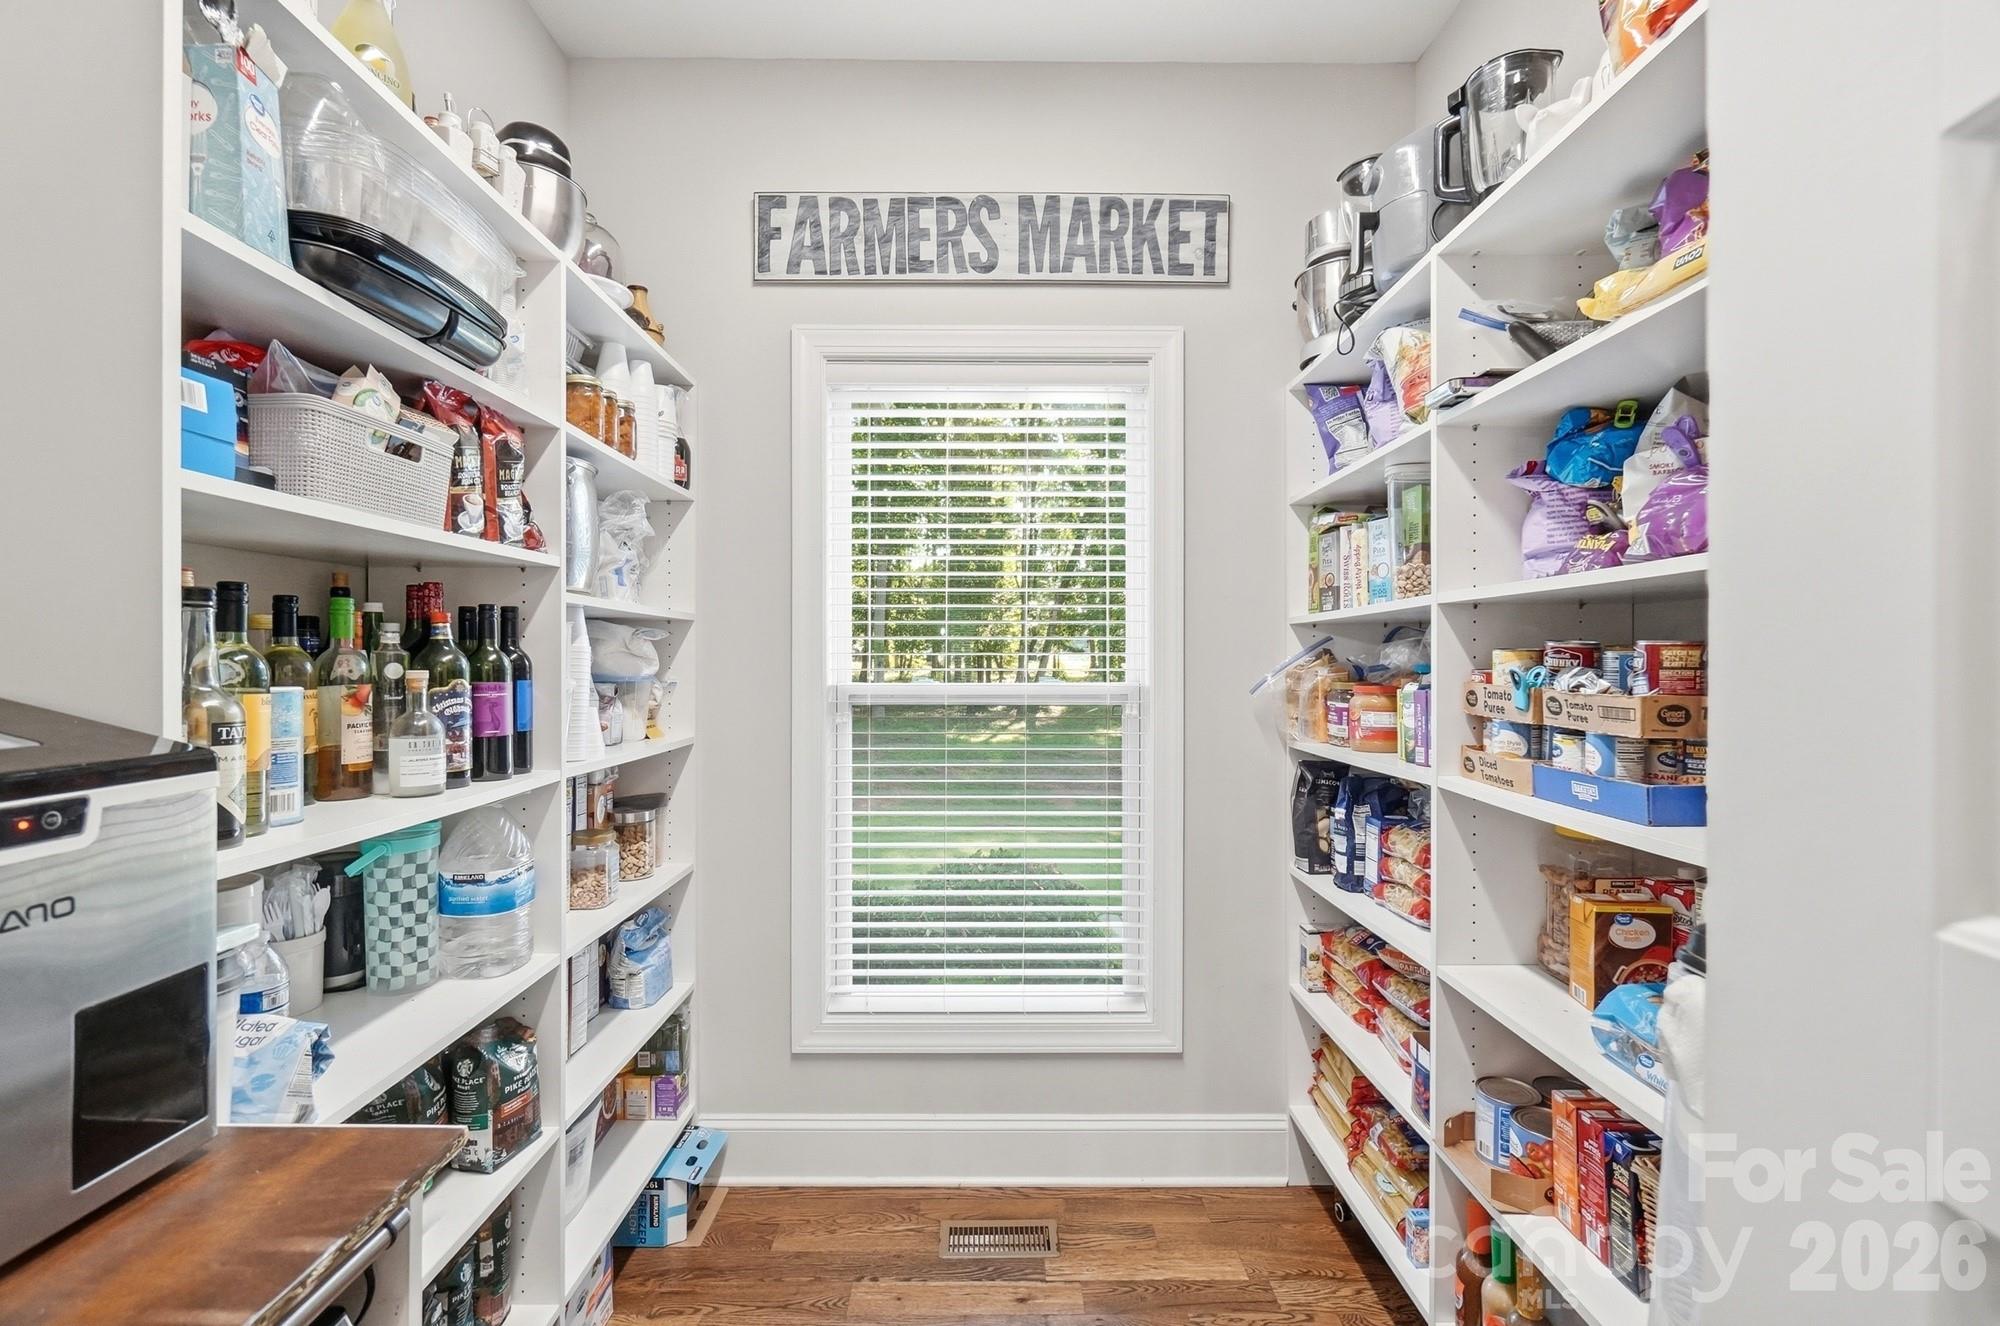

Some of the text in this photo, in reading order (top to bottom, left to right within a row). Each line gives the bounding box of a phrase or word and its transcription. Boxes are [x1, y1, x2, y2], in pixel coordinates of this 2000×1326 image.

[757, 194, 1228, 276] FARMERS MARKET
[1483, 687, 1512, 701] Tomato
[1483, 700, 1506, 714] Puree
[1564, 699, 1594, 711] Tomato
[1567, 711, 1589, 723] Puree
[1479, 756, 1498, 771] Diced
[1480, 769, 1514, 788] Tomatoes
[1615, 928, 1650, 937] Chicken
[461, 1076, 485, 1086] PLACE
[504, 1079, 523, 1094] PIKE
[637, 1194, 647, 1245] FREEZER
